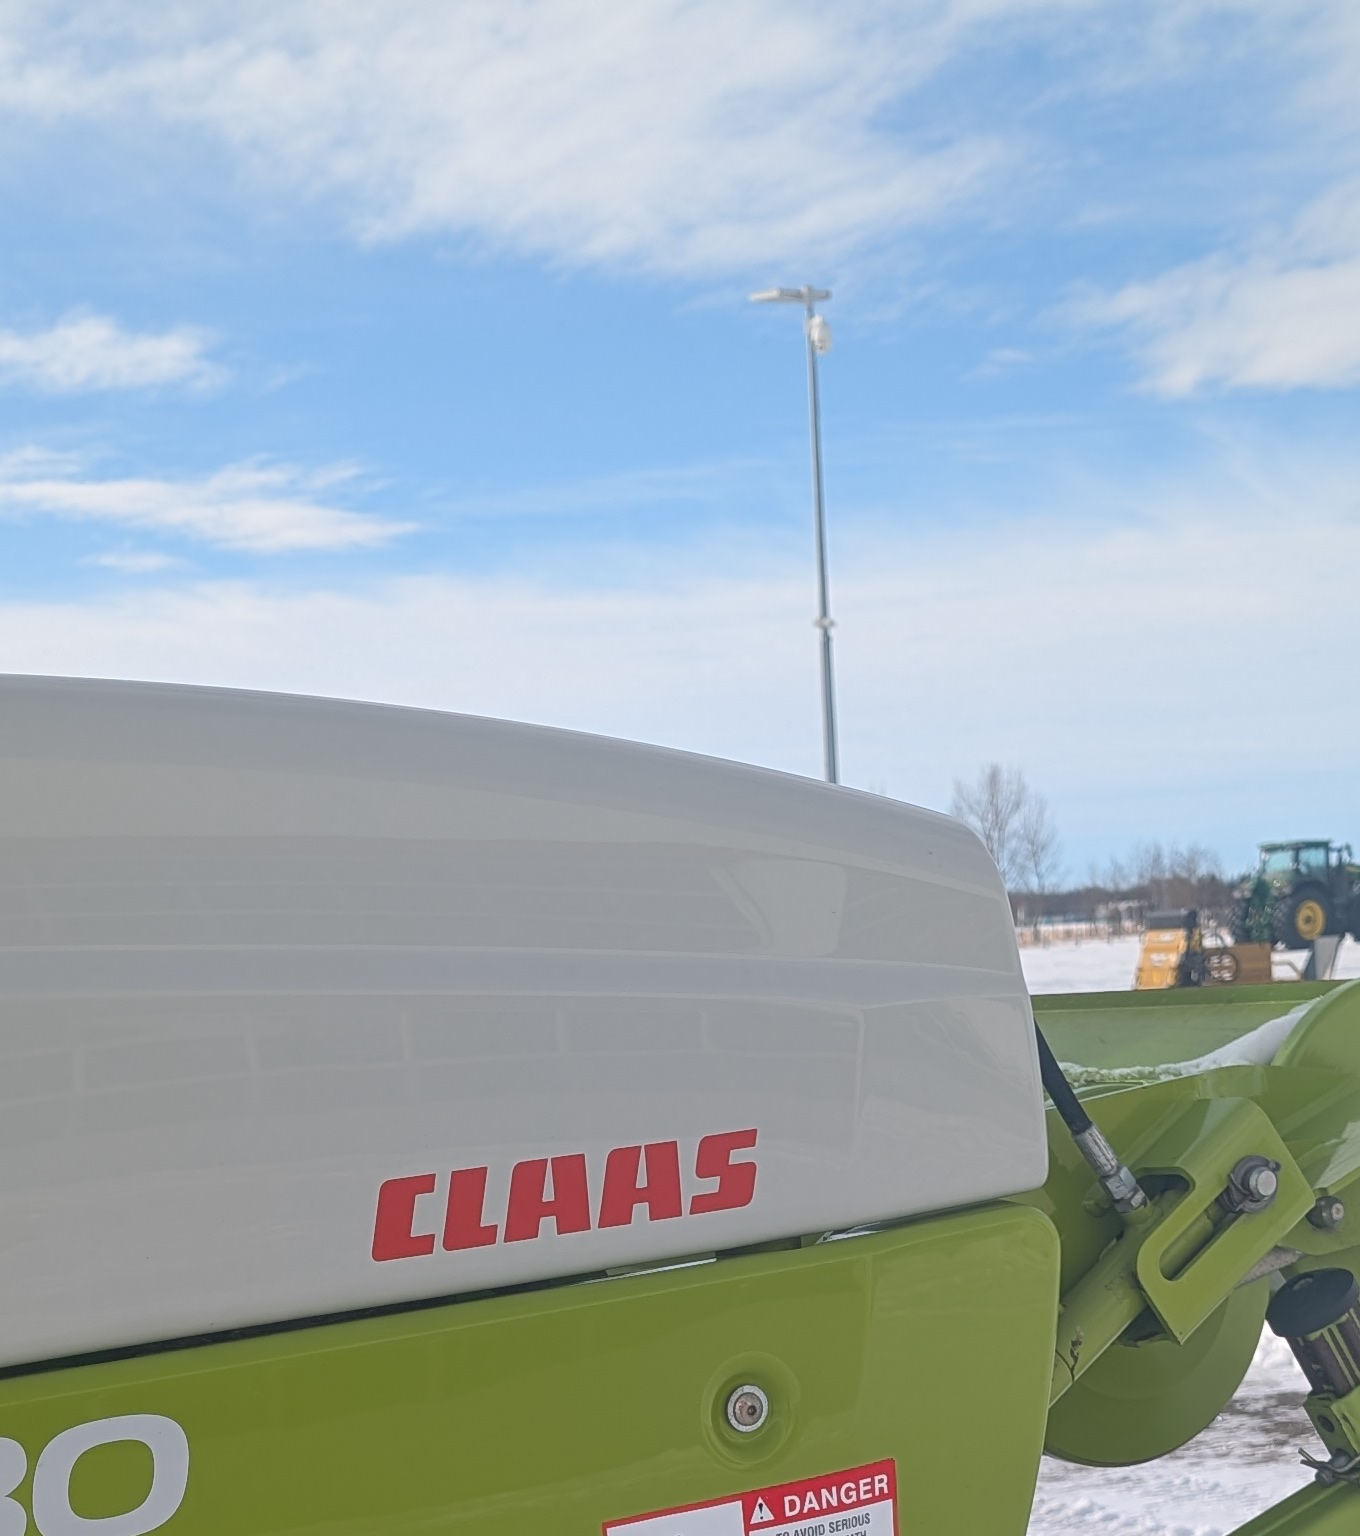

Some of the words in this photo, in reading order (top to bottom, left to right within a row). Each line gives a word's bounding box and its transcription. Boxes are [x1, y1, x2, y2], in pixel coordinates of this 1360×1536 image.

[372, 1128, 758, 1262] CLAAS
[783, 1474, 889, 1517] DANGER
[829, 1513, 870, 1533] SERIOUS
